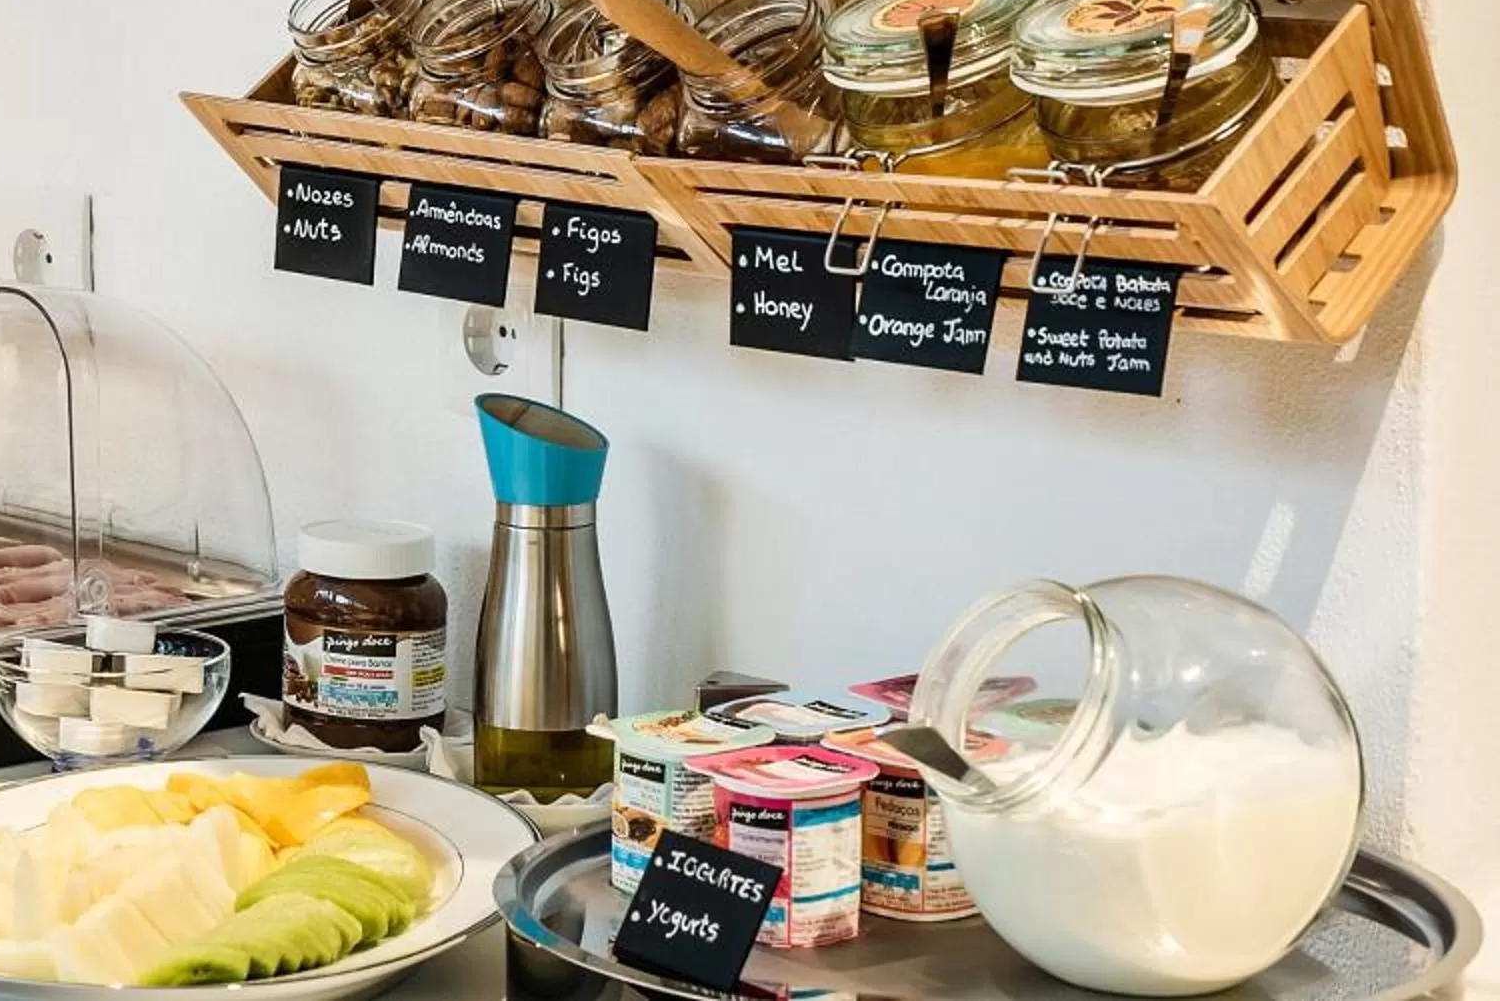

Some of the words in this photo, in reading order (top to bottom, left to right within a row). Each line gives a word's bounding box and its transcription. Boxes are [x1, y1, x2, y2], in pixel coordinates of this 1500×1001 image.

[295, 182, 355, 208] Nozes
[293, 217, 342, 242] Nuts
[415, 198, 501, 230] Amêndoas
[411, 234, 485, 263] Almonds
[567, 216, 622, 254] Figos
[754, 245, 804, 273] Mel
[881, 254, 965, 286] Compota
[562, 262, 601, 296] Figs
[753, 290, 814, 332] Honey
[925, 280, 987, 314] Laranja
[1095, 295, 1107, 310] e
[868, 314, 935, 348] Orange
[1037, 326, 1090, 348] Sweet
[1098, 328, 1148, 350] Potato
[1058, 351, 1096, 368] Nuts
[666, 850, 765, 903] IOGURTES
[646, 899, 721, 943] Yogurts
